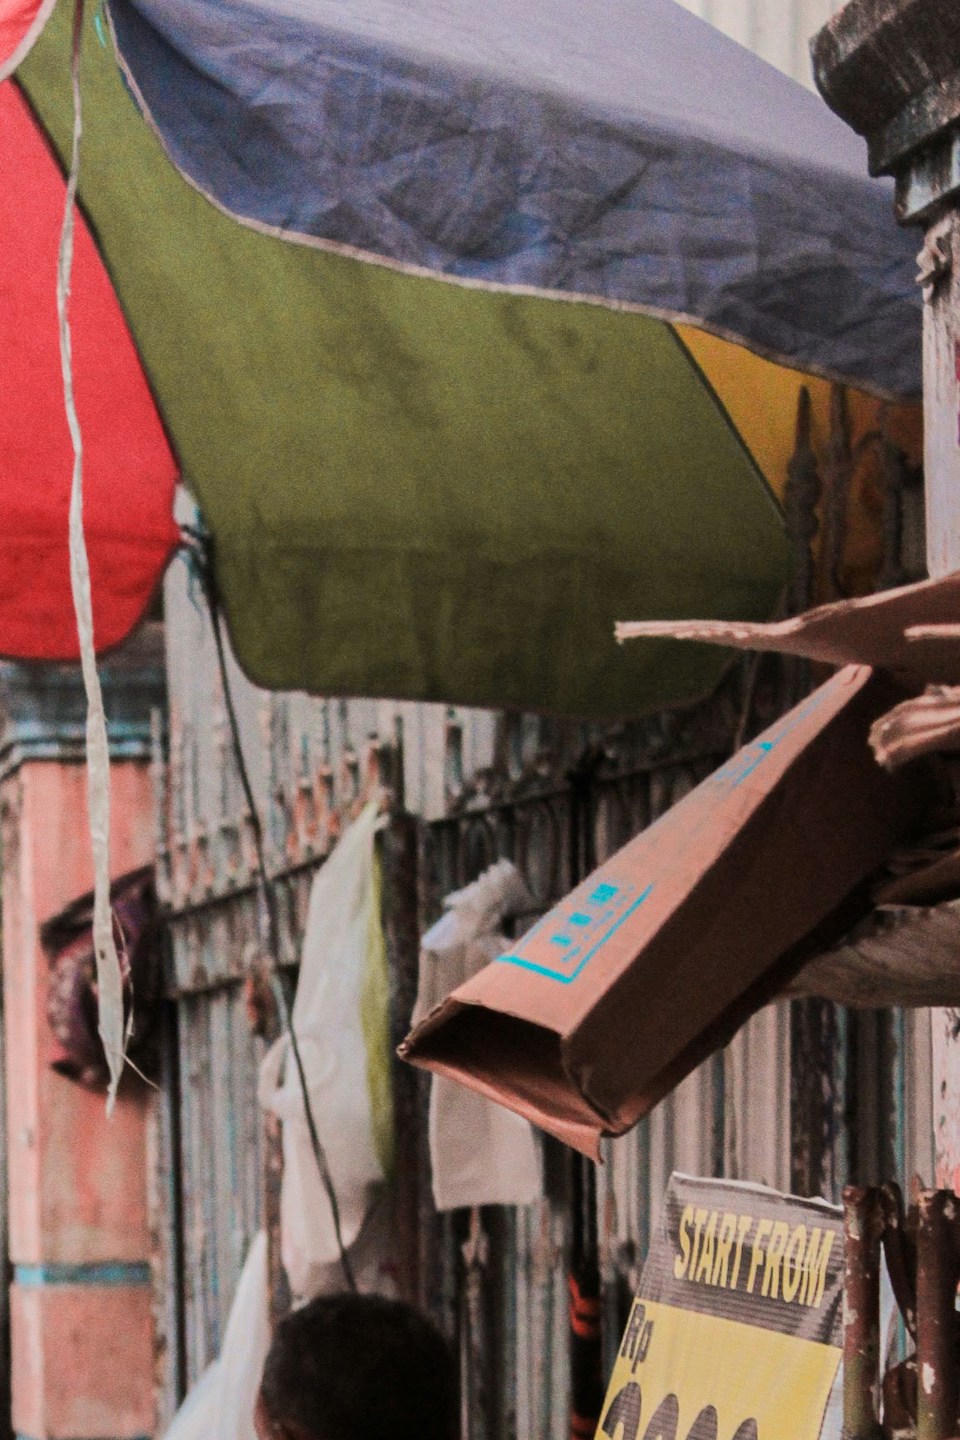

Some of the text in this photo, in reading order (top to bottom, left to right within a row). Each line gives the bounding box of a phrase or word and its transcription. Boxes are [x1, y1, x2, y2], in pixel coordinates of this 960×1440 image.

[674, 1205, 836, 1310] START FROM
[620, 1302, 655, 1374] Rp
